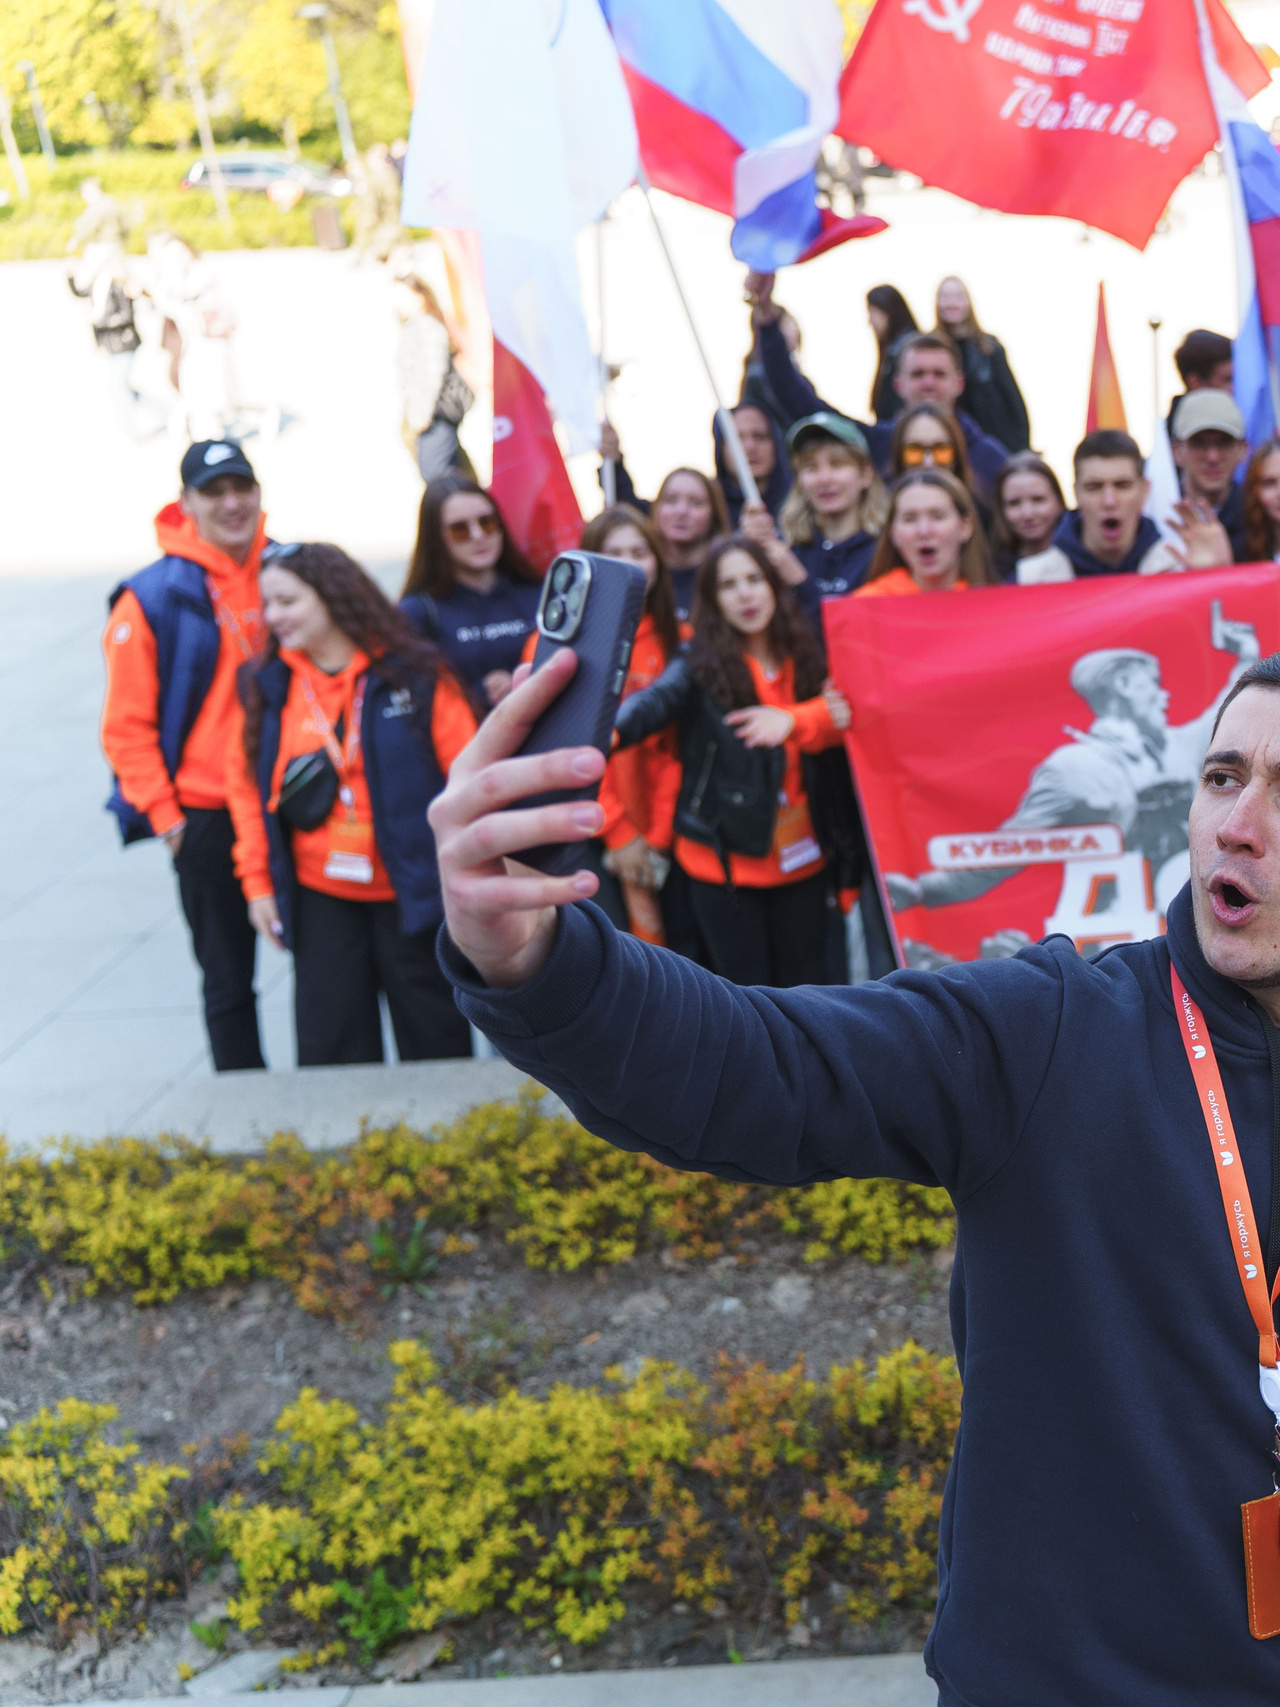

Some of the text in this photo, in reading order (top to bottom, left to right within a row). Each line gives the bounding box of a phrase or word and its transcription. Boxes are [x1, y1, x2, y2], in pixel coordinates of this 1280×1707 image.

[949, 834, 1101, 858] КУБИНКА
[1181, 992, 1199, 1040] я горжусь
[1207, 1089, 1227, 1146] я горжусь
[1233, 1199, 1252, 1258] я горжусь
